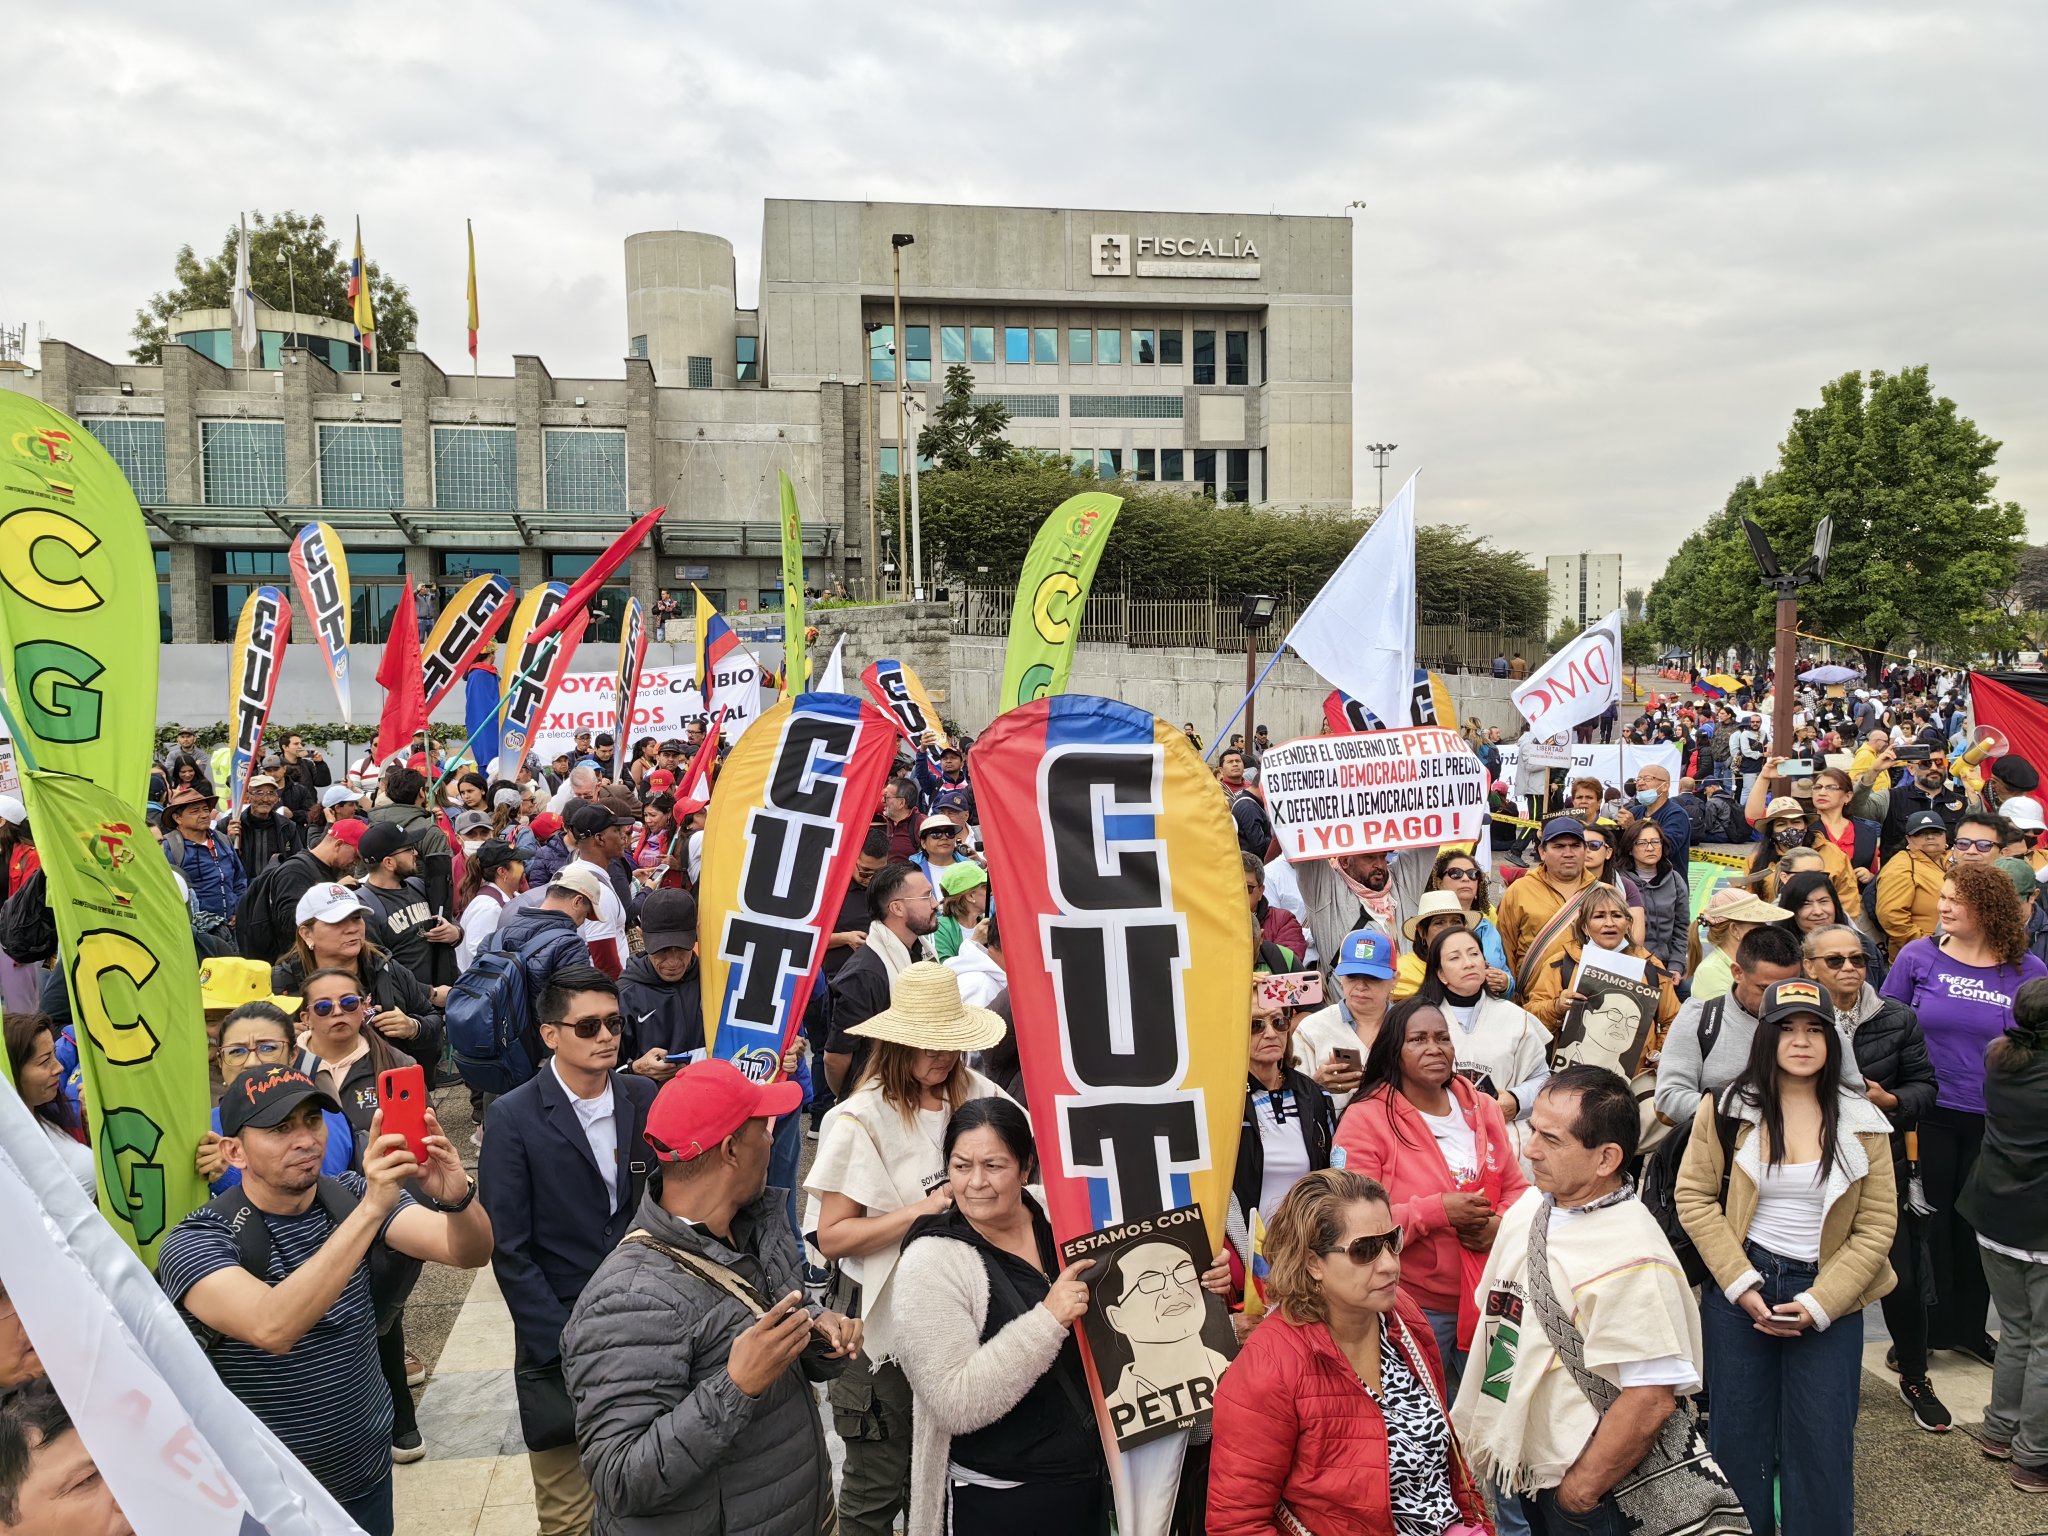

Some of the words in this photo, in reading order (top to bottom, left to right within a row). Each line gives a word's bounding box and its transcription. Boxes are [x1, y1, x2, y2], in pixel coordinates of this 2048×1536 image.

[1137, 231, 1260, 258] FISCALÍA
[303, 530, 346, 655] CUT
[238, 598, 280, 754] CUT
[669, 669, 754, 694] CABIO
[1263, 745, 1318, 769] DEFENDER
[1319, 744, 1333, 761] EL
[1334, 739, 1386, 760] GOBIERNO
[1387, 738, 1402, 755] DE
[1402, 732, 1468, 756] PETRO
[1268, 774, 1280, 793] ES
[1281, 769, 1325, 792] DEFENDER
[1327, 768, 1338, 787] LA
[1340, 759, 1417, 788] DEMOCRACIA
[1432, 758, 1443, 777] EL
[1446, 757, 1481, 776] PRECIO
[1271, 800, 1286, 824] X
[1287, 795, 1339, 823] DEFENDER
[1341, 794, 1355, 817] LA
[1357, 787, 1424, 816] DEMOCRACIA
[1427, 785, 1439, 809] ES
[1442, 784, 1454, 807] LA
[1457, 782, 1483, 806] VIDA
[1314, 823, 1354, 850] YO
[1363, 814, 1443, 844] PAGO
[722, 714, 860, 1030] CUT
[1040, 748, 1208, 1222] CUT
[1584, 967, 1634, 990] ESTAMOS
[1635, 985, 1660, 1000] CON
[1937, 973, 1984, 989] FUERZA
[1949, 984, 2012, 1005] Común
[1064, 1220, 1152, 1258] ESTAMOS
[1157, 1207, 1200, 1229] CON
[1108, 1367, 1227, 1438] PETR
[1177, 1416, 1197, 1430] Hey!
